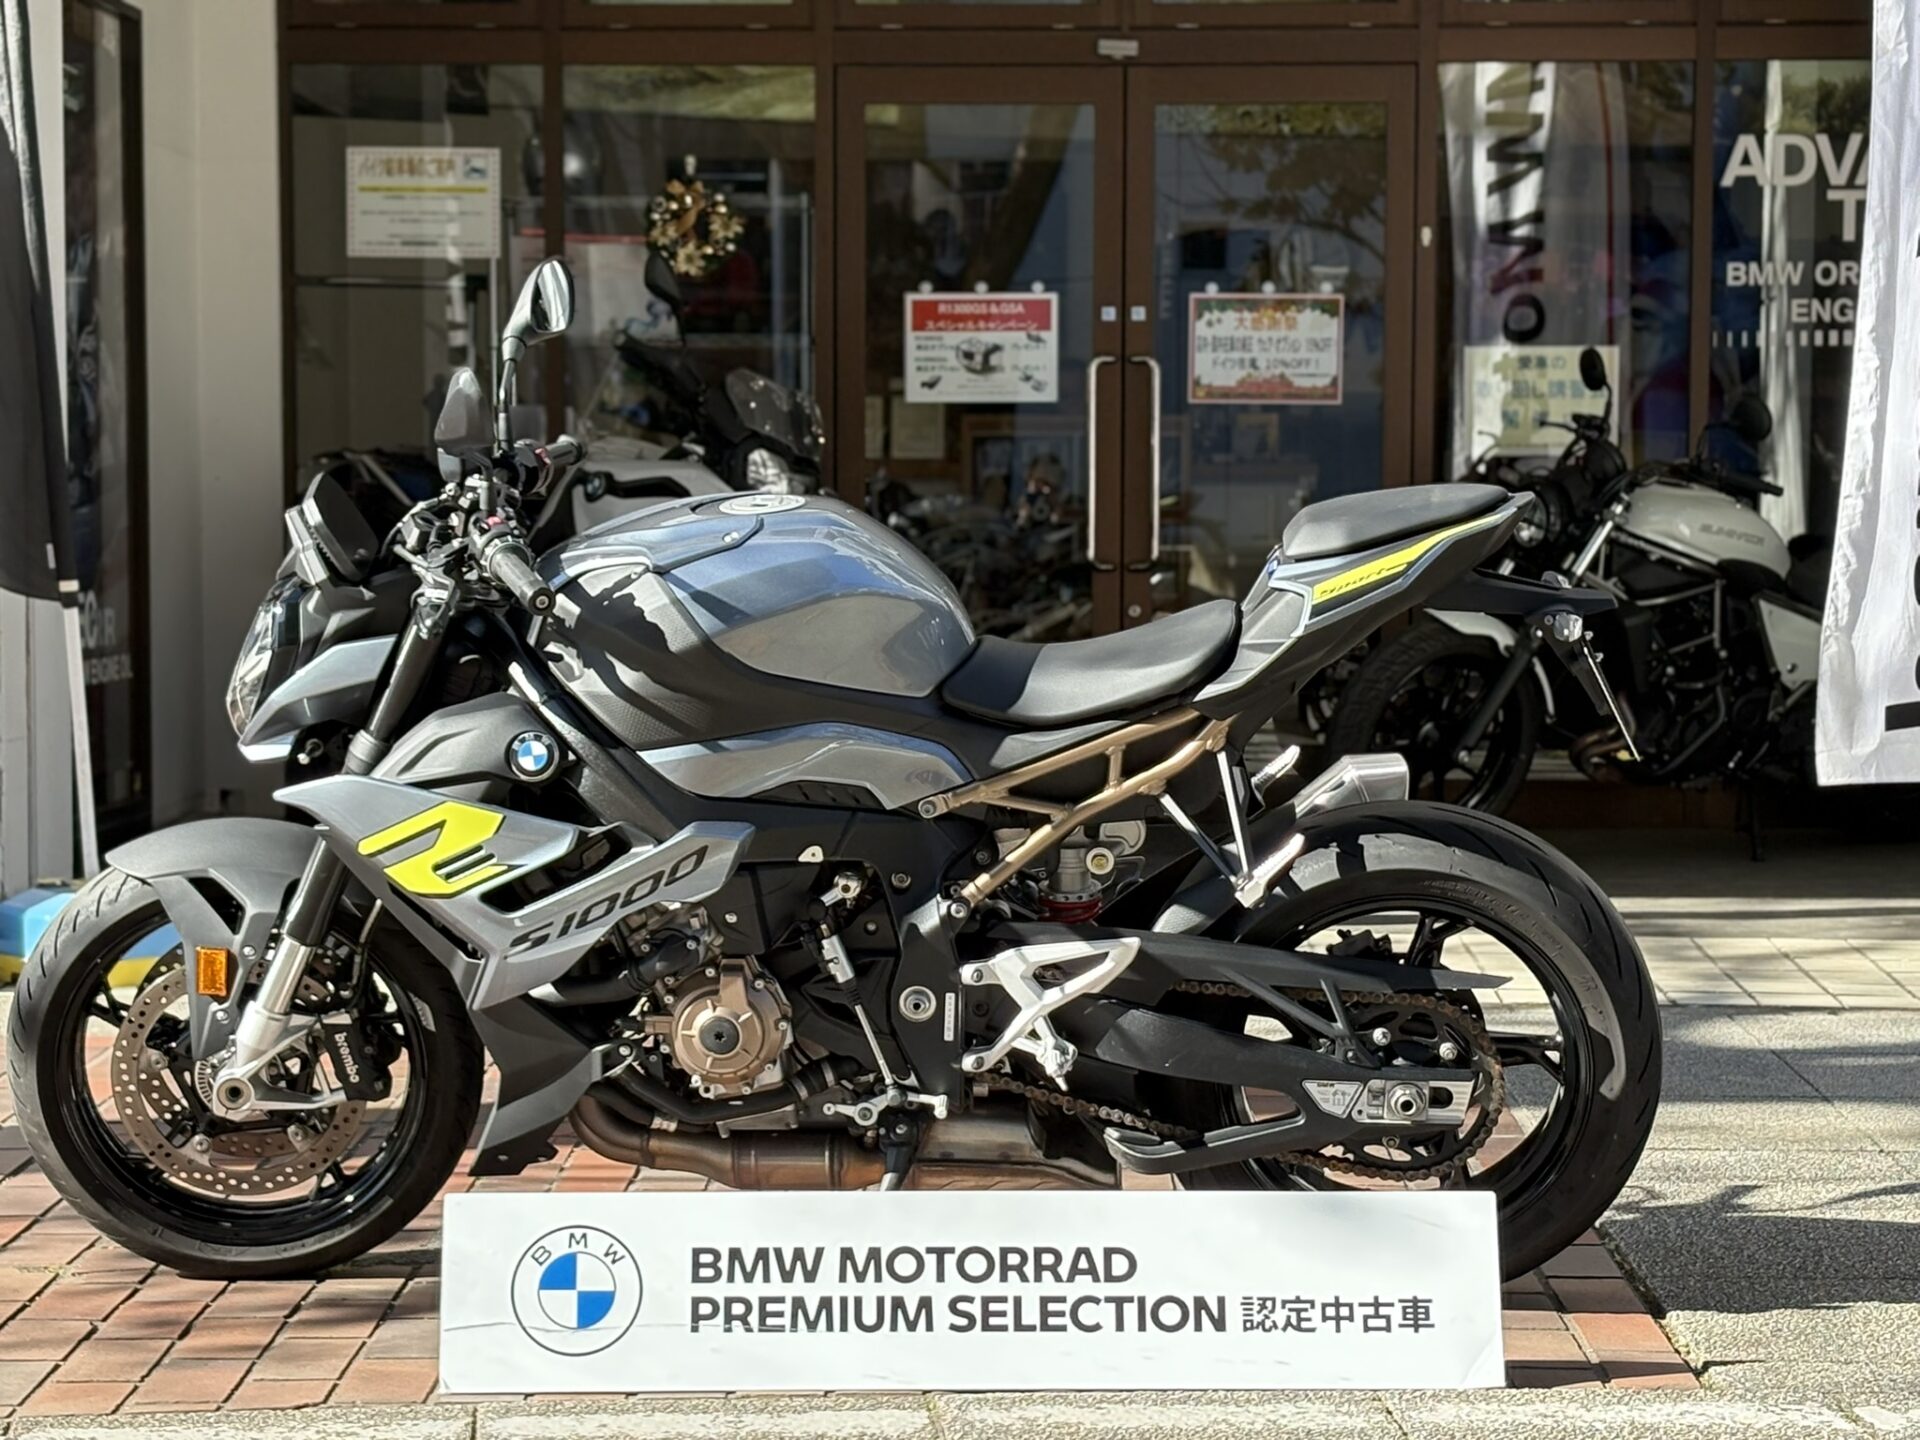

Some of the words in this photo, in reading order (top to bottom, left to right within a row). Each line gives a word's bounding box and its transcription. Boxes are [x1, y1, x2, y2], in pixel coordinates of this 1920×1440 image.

[1719, 133, 1869, 187] ADV
[1726, 261, 1804, 287] BMW
[502, 844, 710, 960] S1000
[333, 1031, 361, 1084] brembo
[530, 1232, 626, 1267] BMW
[690, 1245, 825, 1284] BMW
[838, 1245, 1138, 1284] MOTORRAD
[690, 1295, 934, 1333] PREMIUM
[948, 1295, 1227, 1333] SELECTION
[1240, 1295, 1436, 1333] 認定中古車
